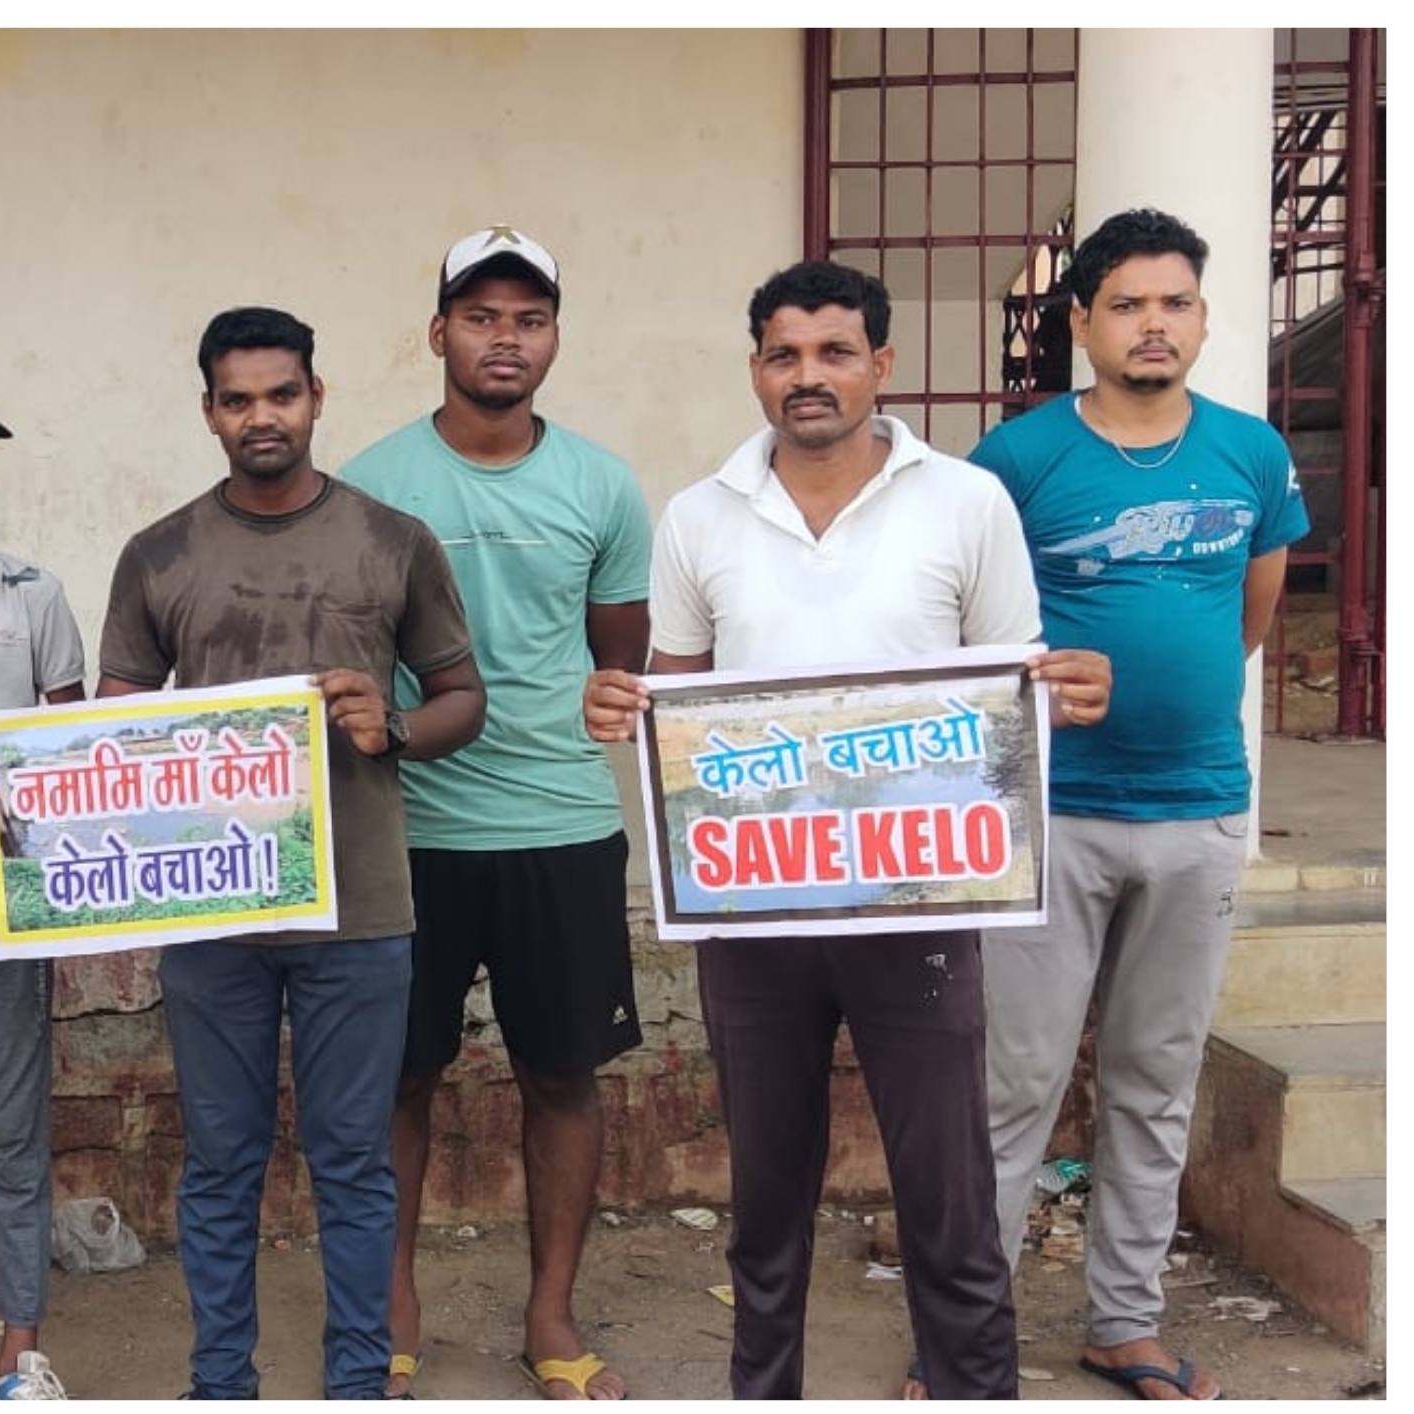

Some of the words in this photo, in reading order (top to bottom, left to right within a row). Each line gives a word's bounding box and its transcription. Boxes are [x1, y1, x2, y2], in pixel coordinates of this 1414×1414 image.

[14, 744, 143, 818] नमामि
[153, 735, 200, 805] माँ
[208, 729, 292, 800] केलो
[696, 723, 804, 793] केलो
[823, 699, 980, 773] बचाओ
[48, 835, 128, 905] केलो
[138, 823, 253, 897] बचाओ
[692, 815, 845, 887] SAVE
[858, 804, 1006, 879] KELO
